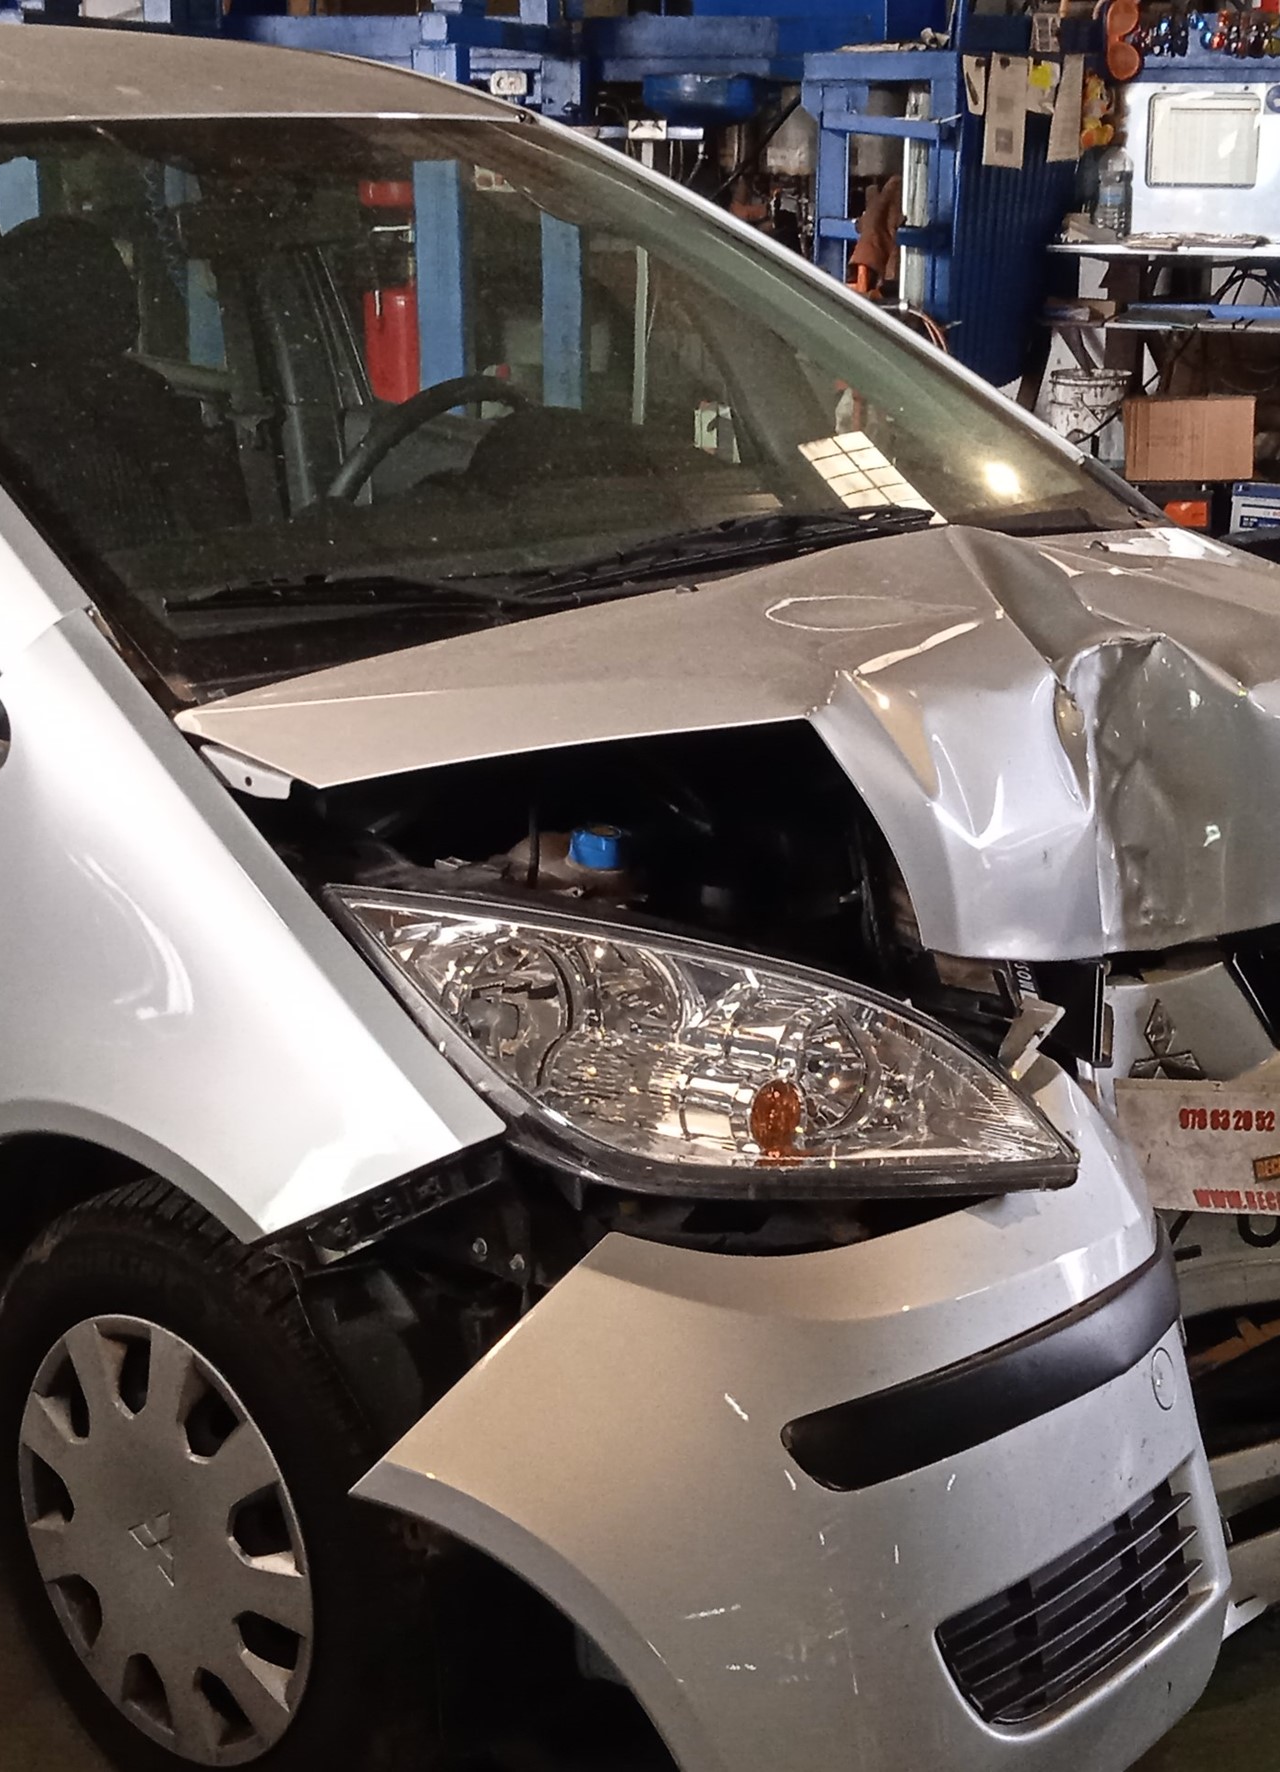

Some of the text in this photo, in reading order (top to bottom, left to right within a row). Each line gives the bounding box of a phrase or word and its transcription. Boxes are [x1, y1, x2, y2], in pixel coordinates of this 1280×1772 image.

[1179, 1108, 1208, 1130] 978
[1233, 1109, 1253, 1131] 20
[1255, 1110, 1276, 1132] 52
